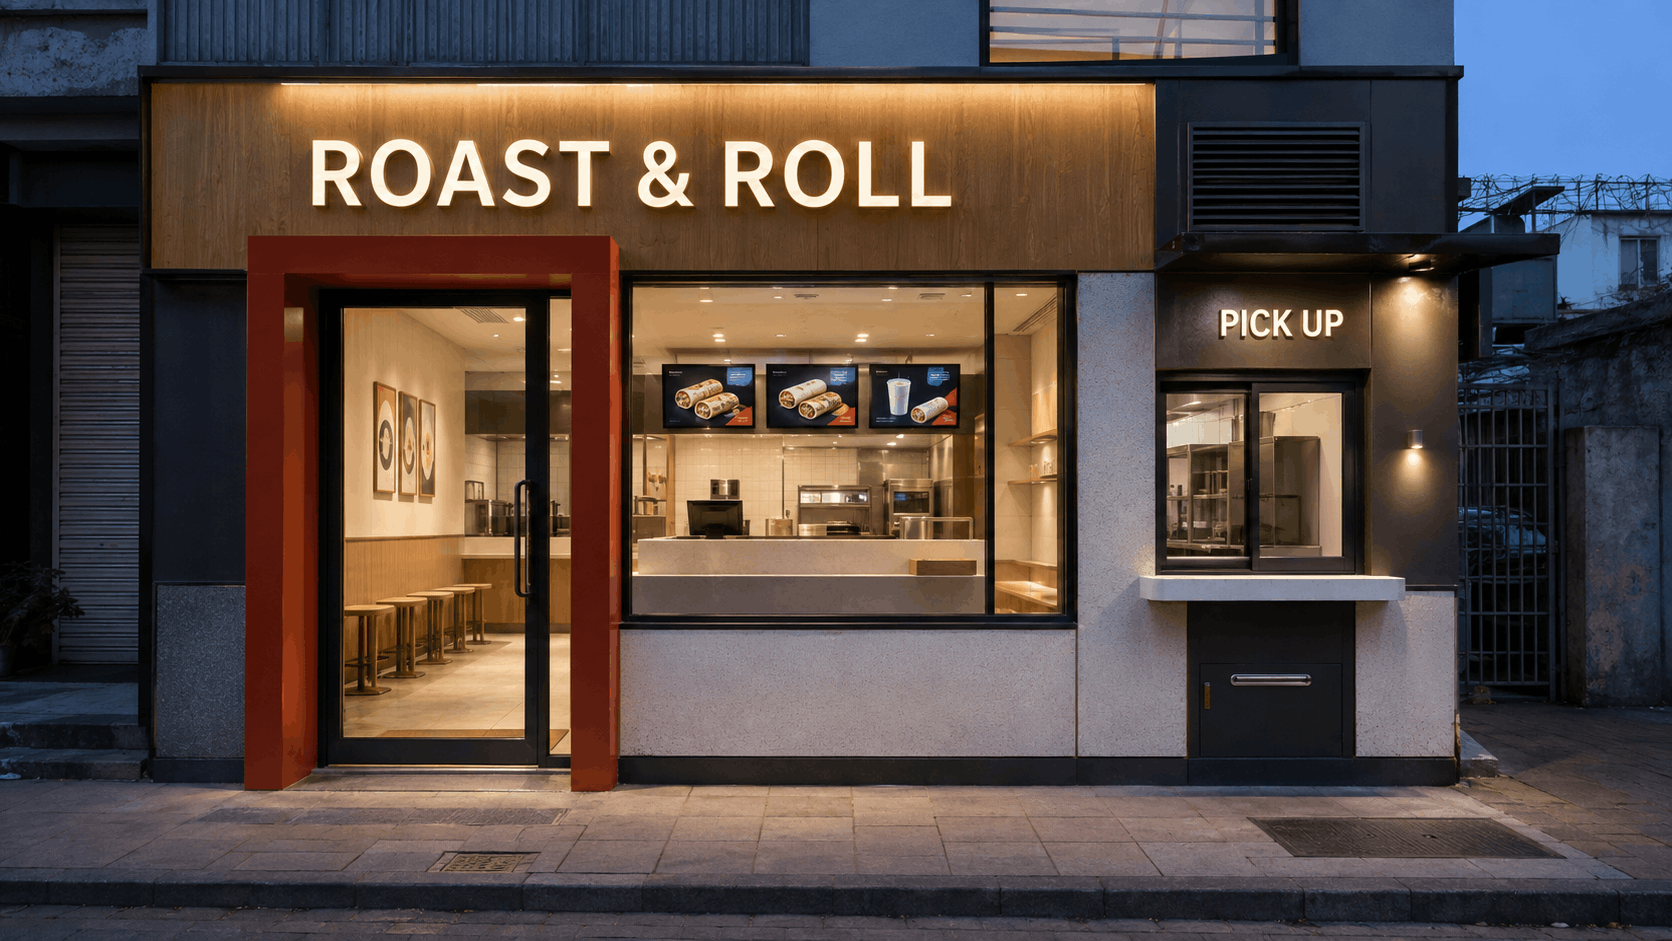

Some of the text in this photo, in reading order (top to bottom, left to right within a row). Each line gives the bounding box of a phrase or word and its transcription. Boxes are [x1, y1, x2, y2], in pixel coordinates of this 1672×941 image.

[312, 139, 952, 208] ROAST & ROLL
[1221, 309, 1344, 338] PICK UP
